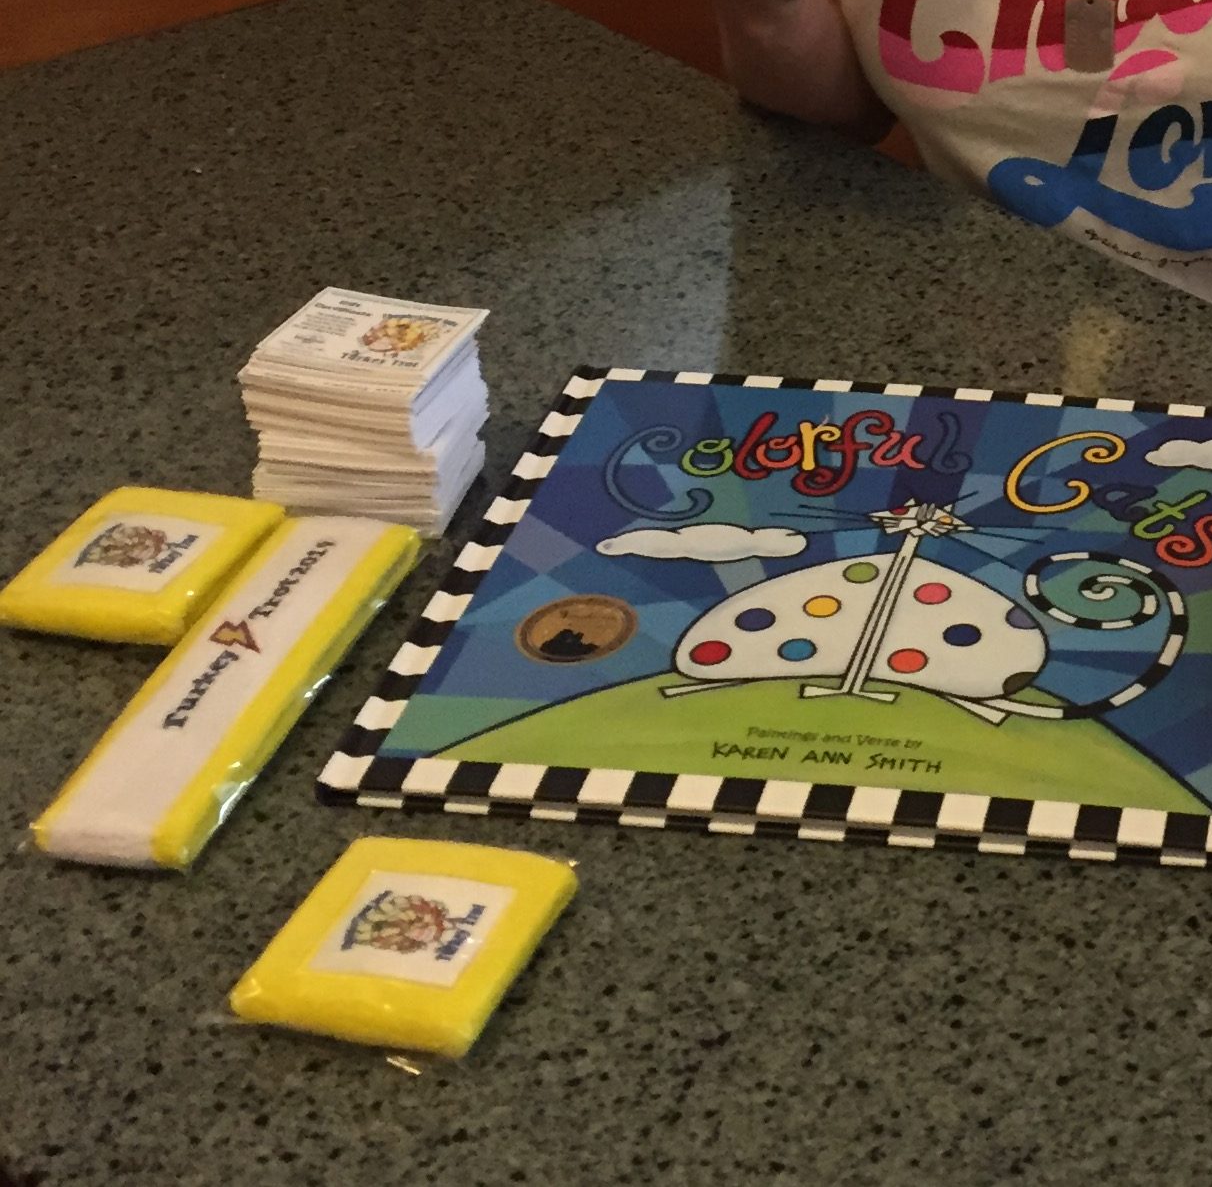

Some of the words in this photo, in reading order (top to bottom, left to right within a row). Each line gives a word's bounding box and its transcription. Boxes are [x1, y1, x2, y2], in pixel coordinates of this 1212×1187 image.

[603, 409, 972, 521] Colorful
[162, 649, 240, 730] Turkey
[710, 740, 791, 762] KAREN
[801, 748, 854, 766] ANN
[864, 751, 943, 775] SMITH
[747, 725, 819, 743] Paintings
[822, 731, 852, 744] and
[855, 733, 901, 748] Verse
